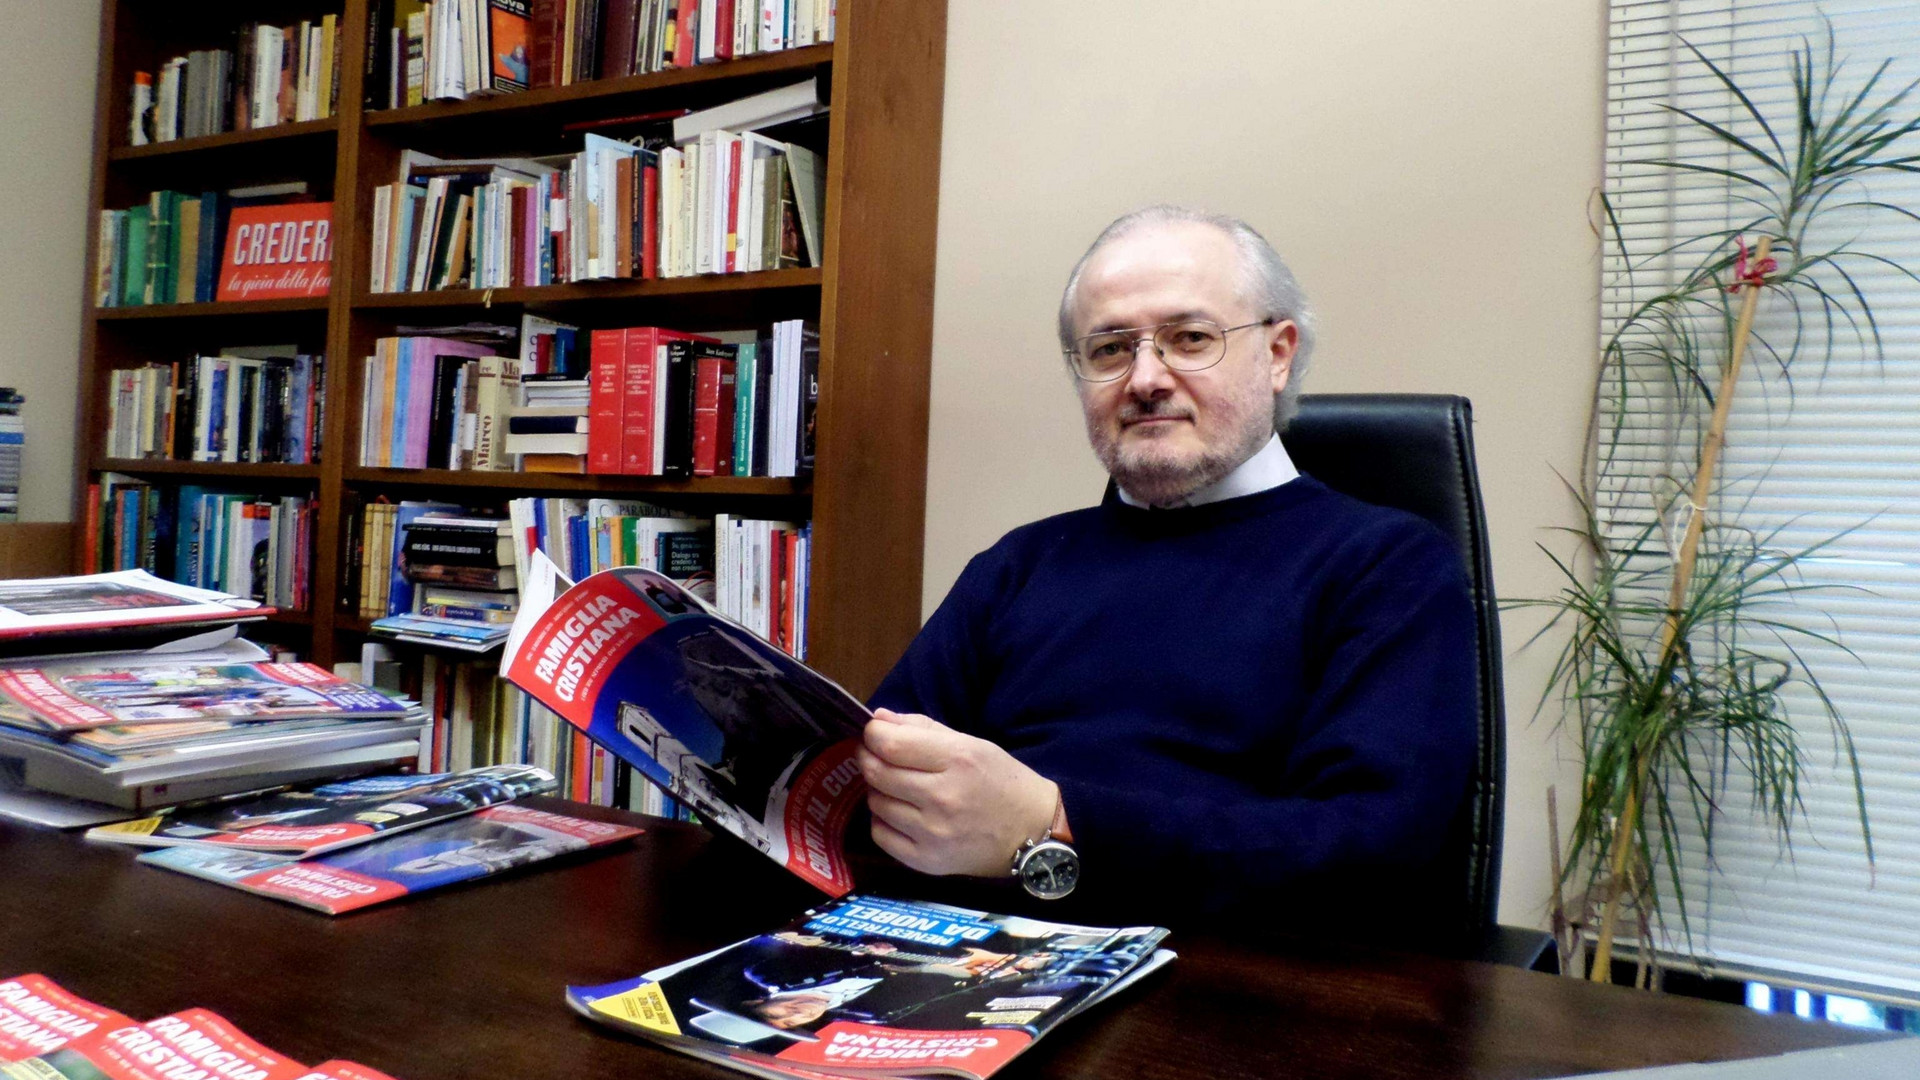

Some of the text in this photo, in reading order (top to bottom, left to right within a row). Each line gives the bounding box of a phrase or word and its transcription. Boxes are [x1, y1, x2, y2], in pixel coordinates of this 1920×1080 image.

[234, 219, 333, 265] CREDER
[227, 271, 242, 291] la
[242, 274, 274, 298] gioia
[275, 268, 309, 289] della
[477, 415, 492, 466] Marco
[534, 594, 618, 685] FAMIGLIA
[554, 606, 641, 702] CRISTIANA
[807, 796, 831, 822] AL
[821, 756, 862, 798] CUO
[266, 874, 352, 900] FAMIGLIA
[284, 867, 378, 894] CRISTIANA
[810, 923, 840, 934] DYLAN
[821, 914, 956, 946] MENESTRELLO
[844, 905, 940, 931] NOBEL
[943, 924, 990, 940] DA
[0, 981, 98, 1037] FAMIGLIA
[0, 1005, 69, 1050] STIANA
[107, 1026, 222, 1080] CRISTIA
[146, 1015, 269, 1080] FAMIGLIA
[823, 1043, 976, 1058] FAMIGLIA
[831, 1031, 999, 1048] CRISTIANA
